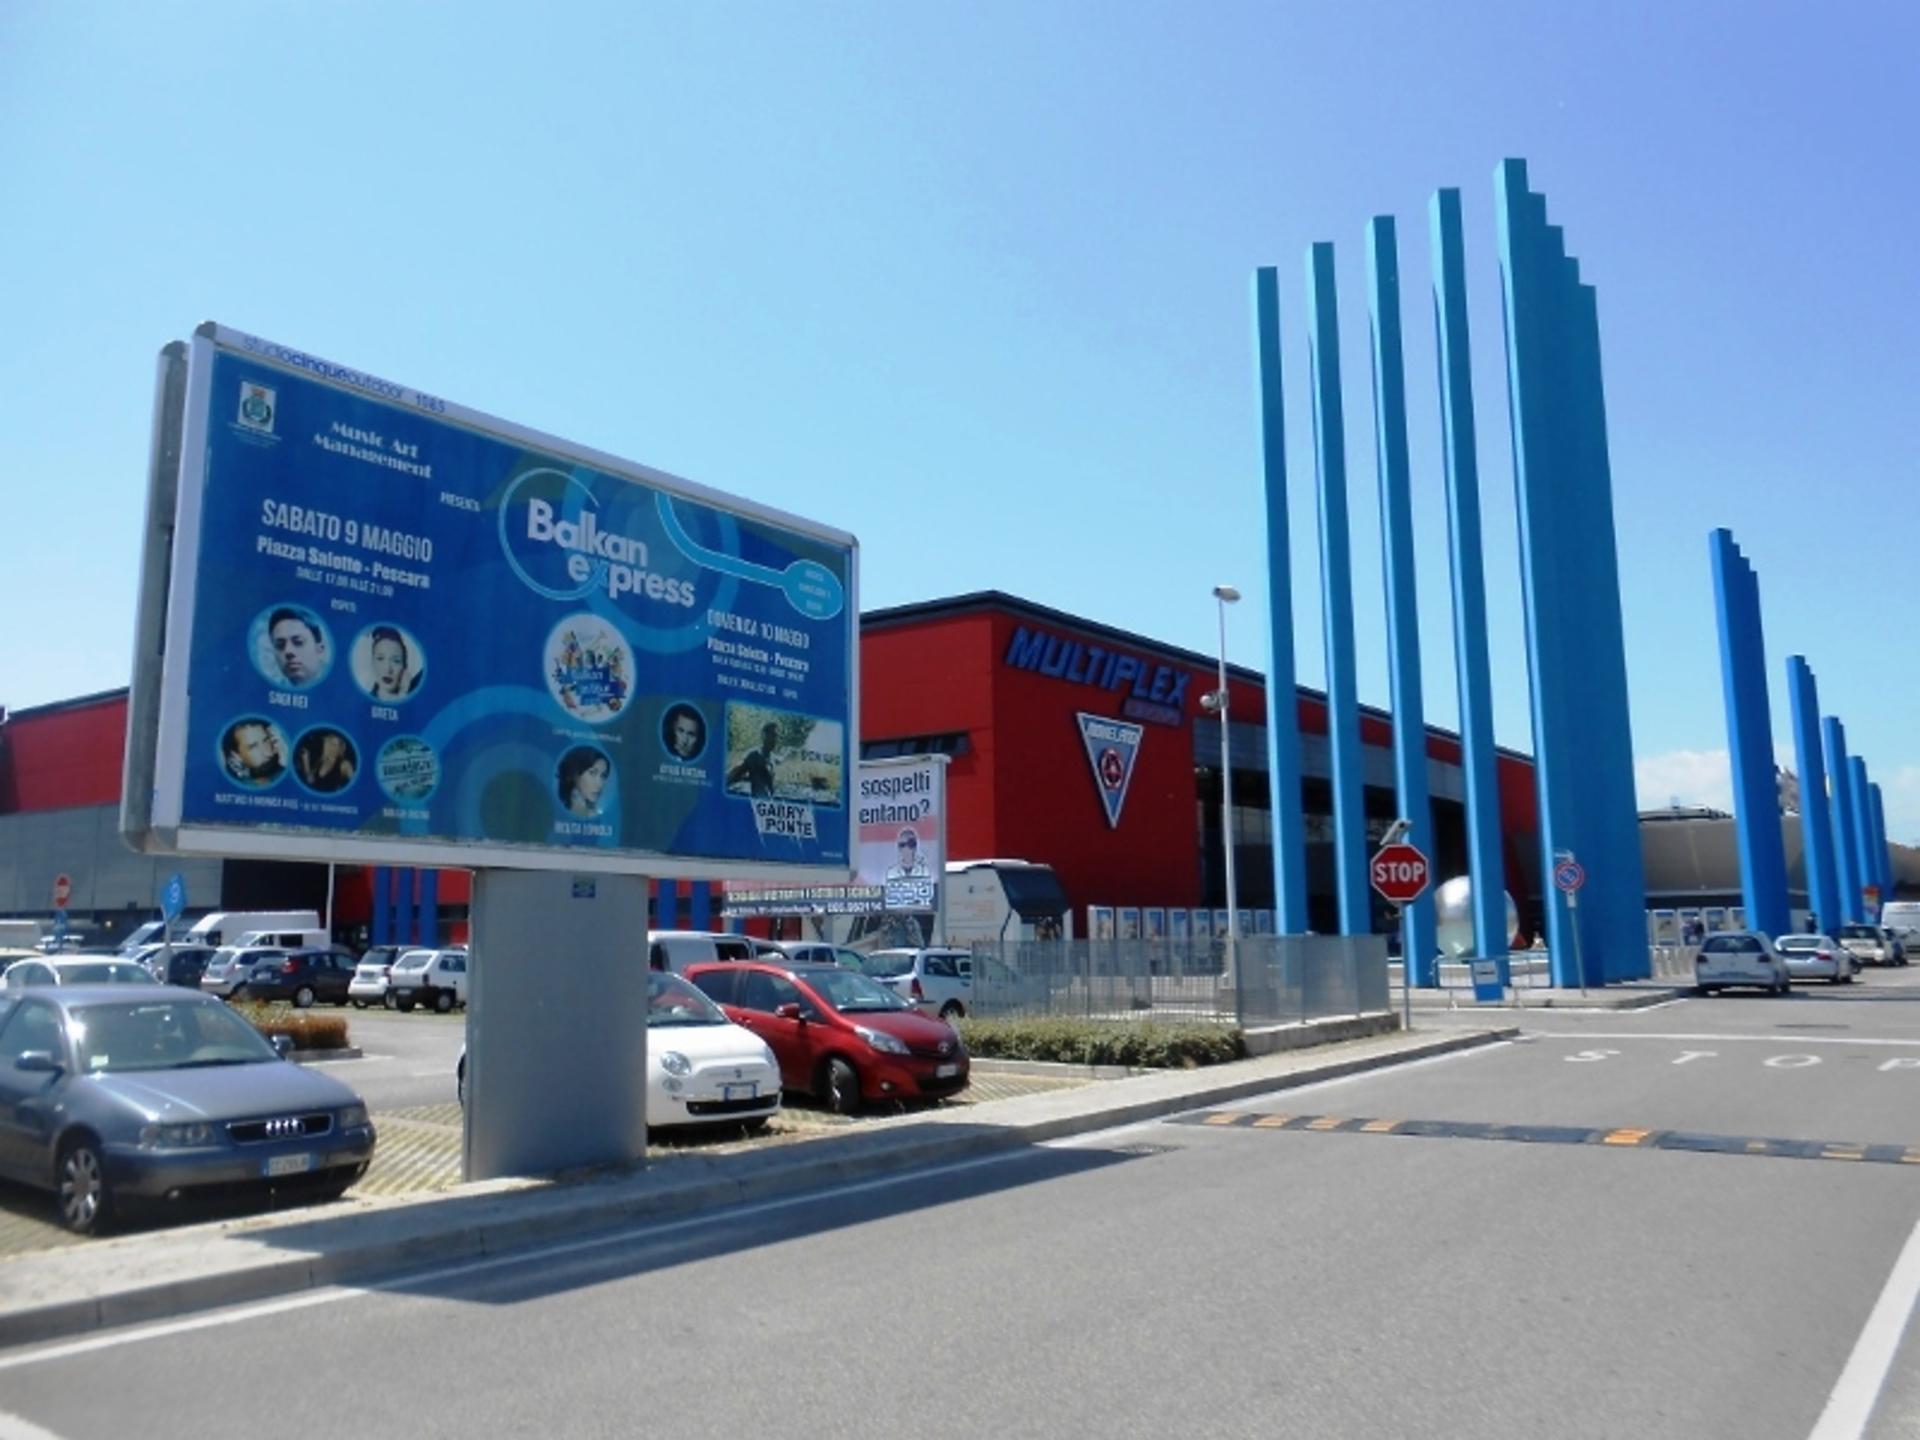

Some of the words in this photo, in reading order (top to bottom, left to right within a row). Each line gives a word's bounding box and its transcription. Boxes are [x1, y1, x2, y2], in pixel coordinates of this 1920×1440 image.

[392, 438, 420, 460] Art
[262, 498, 341, 542] SABATO
[345, 520, 359, 546] 9
[362, 524, 433, 563] MAGGIO
[527, 498, 648, 567] Balkan
[256, 534, 306, 563] Piazza
[372, 561, 431, 589] Pescara
[567, 551, 696, 608] express
[1006, 625, 1191, 706] MULTIPLEX
[860, 769, 931, 801] sospetti
[764, 817, 812, 836] PONTE
[1375, 862, 1425, 883] STOP
